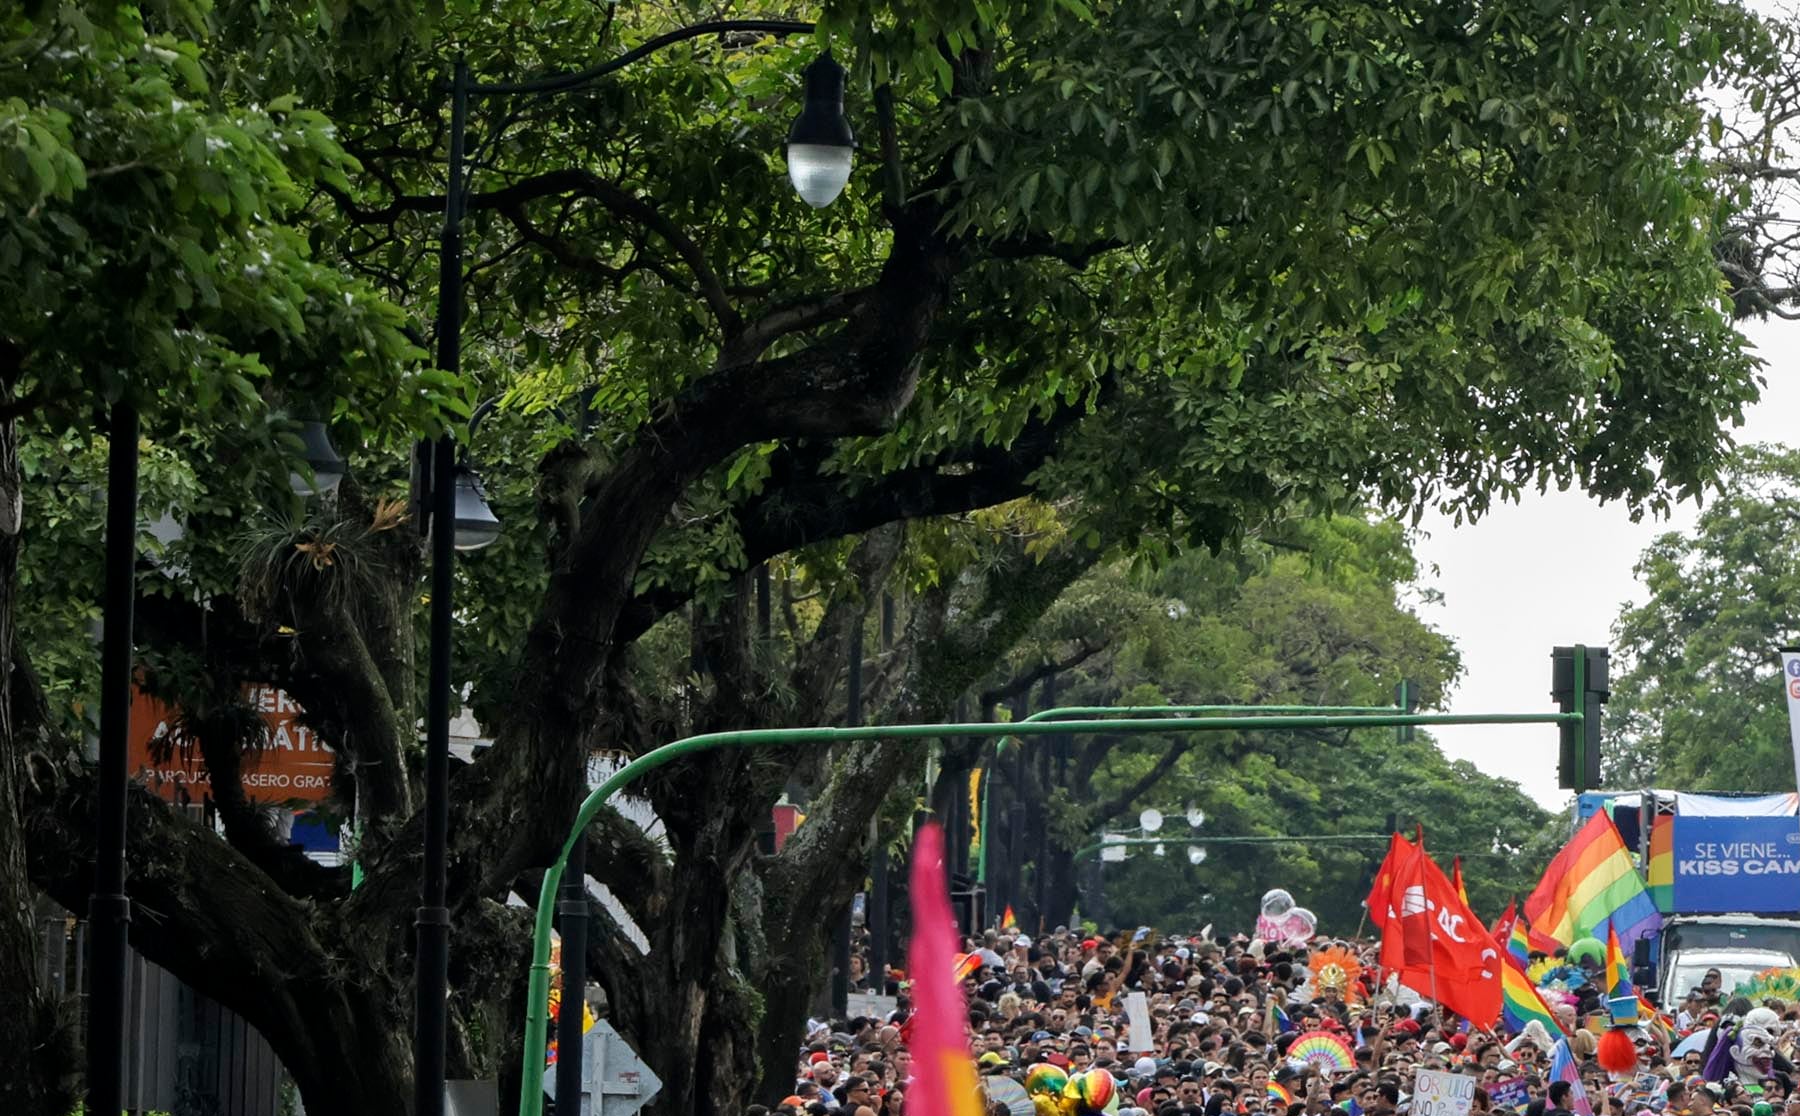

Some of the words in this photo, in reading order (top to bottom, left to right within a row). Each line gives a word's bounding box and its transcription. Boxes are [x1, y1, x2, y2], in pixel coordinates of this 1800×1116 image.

[1695, 843, 1717, 859] SE
[1720, 843, 1790, 859] VIENE...
[1679, 860, 1739, 876] KISS
